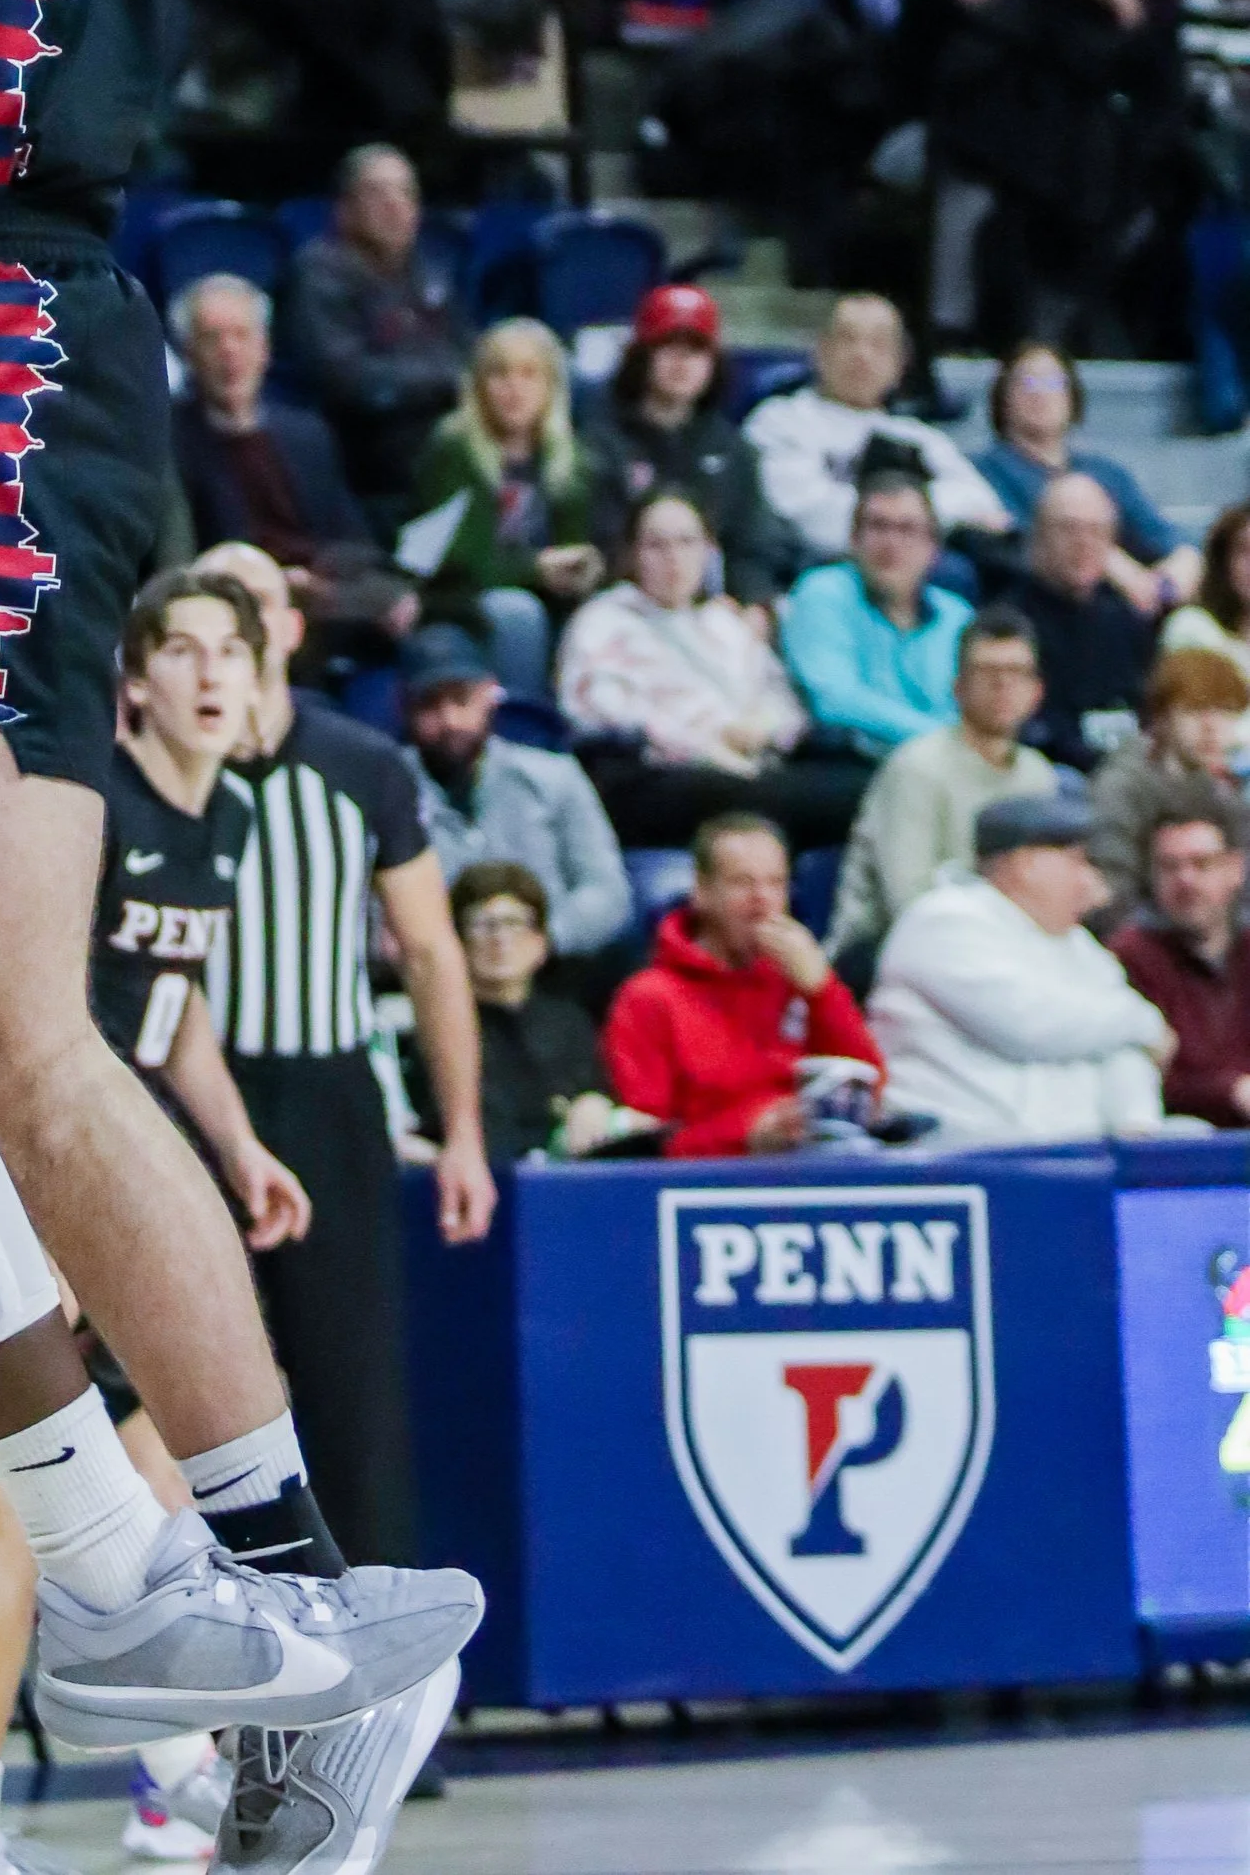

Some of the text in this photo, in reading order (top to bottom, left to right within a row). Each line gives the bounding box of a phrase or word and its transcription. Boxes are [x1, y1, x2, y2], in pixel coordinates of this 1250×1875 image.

[109, 899, 233, 959] PEN
[135, 971, 190, 1068] 0
[692, 1221, 959, 1306] PENN
[783, 1363, 909, 1557] P
